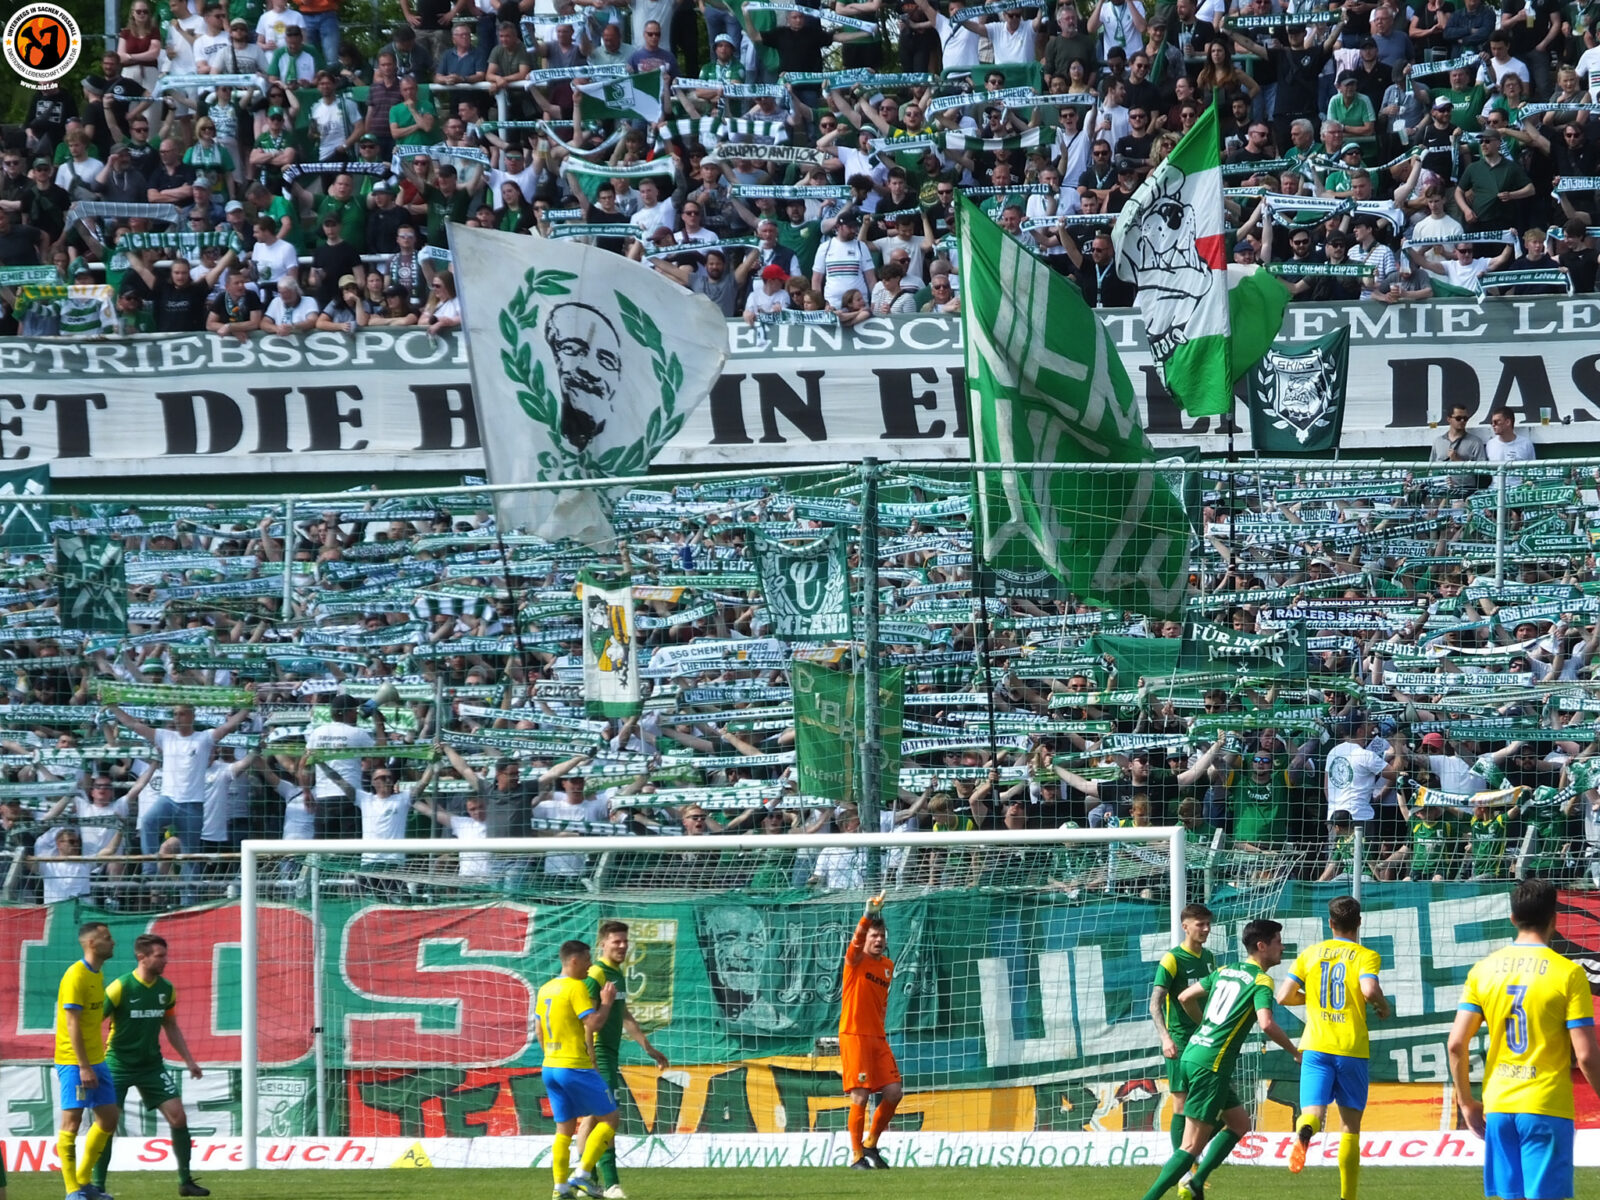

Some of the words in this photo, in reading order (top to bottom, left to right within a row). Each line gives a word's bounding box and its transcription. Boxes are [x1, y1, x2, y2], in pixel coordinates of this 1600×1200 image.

[1236, 16, 1282, 27] CHEMIE
[1285, 13, 1330, 24] LEIPZIG
[716, 144, 769, 159] GRUPPO
[1005, 183, 1049, 194] LEIPZIG
[548, 209, 583, 219] CHEMIE
[430, 247, 448, 259] BSG
[1282, 264, 1299, 274] BSG
[1299, 264, 1330, 275] CHEMIE
[1330, 265, 1359, 276] LEIPZIG
[1276, 359, 1316, 370] SKINS
[155, 384, 368, 457] DIE
[708, 369, 828, 445] IN
[624, 492, 662, 503] LEIPZIG
[1470, 495, 1492, 508] BSG
[1497, 491, 1533, 505] HEMIE
[1534, 487, 1574, 501] LEIPZIG
[1533, 537, 1574, 546] CHEMIE
[1007, 588, 1050, 599] JAHRE
[1239, 590, 1287, 602] LEIPZIG
[1465, 587, 1488, 601] BSG
[1532, 584, 1572, 598] LEIPZIG
[1276, 608, 1337, 621] RADLERS
[1337, 610, 1374, 623] BSGE
[1498, 607, 1520, 623] BSG
[1521, 602, 1561, 618] CHEMIE
[1562, 597, 1600, 613] LEIPZIG
[1014, 613, 1102, 630] VENCEREMOS
[1190, 622, 1232, 649] FÜR
[1233, 627, 1302, 653] IMMER
[669, 650, 689, 660] BSG
[690, 646, 728, 658] CHEMIE
[730, 642, 769, 653] LEIPZIG
[1207, 645, 1248, 663] MIT
[1250, 645, 1286, 668] DIR
[1053, 666, 1095, 679] LEIPZIG
[1395, 673, 1436, 685] CHEMIE
[1475, 673, 1519, 685] FOREVER
[932, 695, 977, 704] LEIPZIG
[1559, 698, 1581, 709] BSG
[1273, 706, 1324, 720] CHEMIE
[1039, 722, 1088, 732] LEIPZIG
[442, 733, 593, 756] SCHLACHTENBUMMLER
[937, 736, 954, 749] DIE
[956, 735, 973, 748] BSG
[804, 766, 844, 784] CHEMIE
[1317, 947, 1356, 961] LEIPZIG
[1494, 957, 1550, 976] LEIPZIG
[1319, 960, 1347, 1012] 18
[1203, 979, 1242, 1026] 10
[1505, 984, 1529, 1055] 3
[707, 1136, 1151, 1168] www.klasik-hausboot.de
